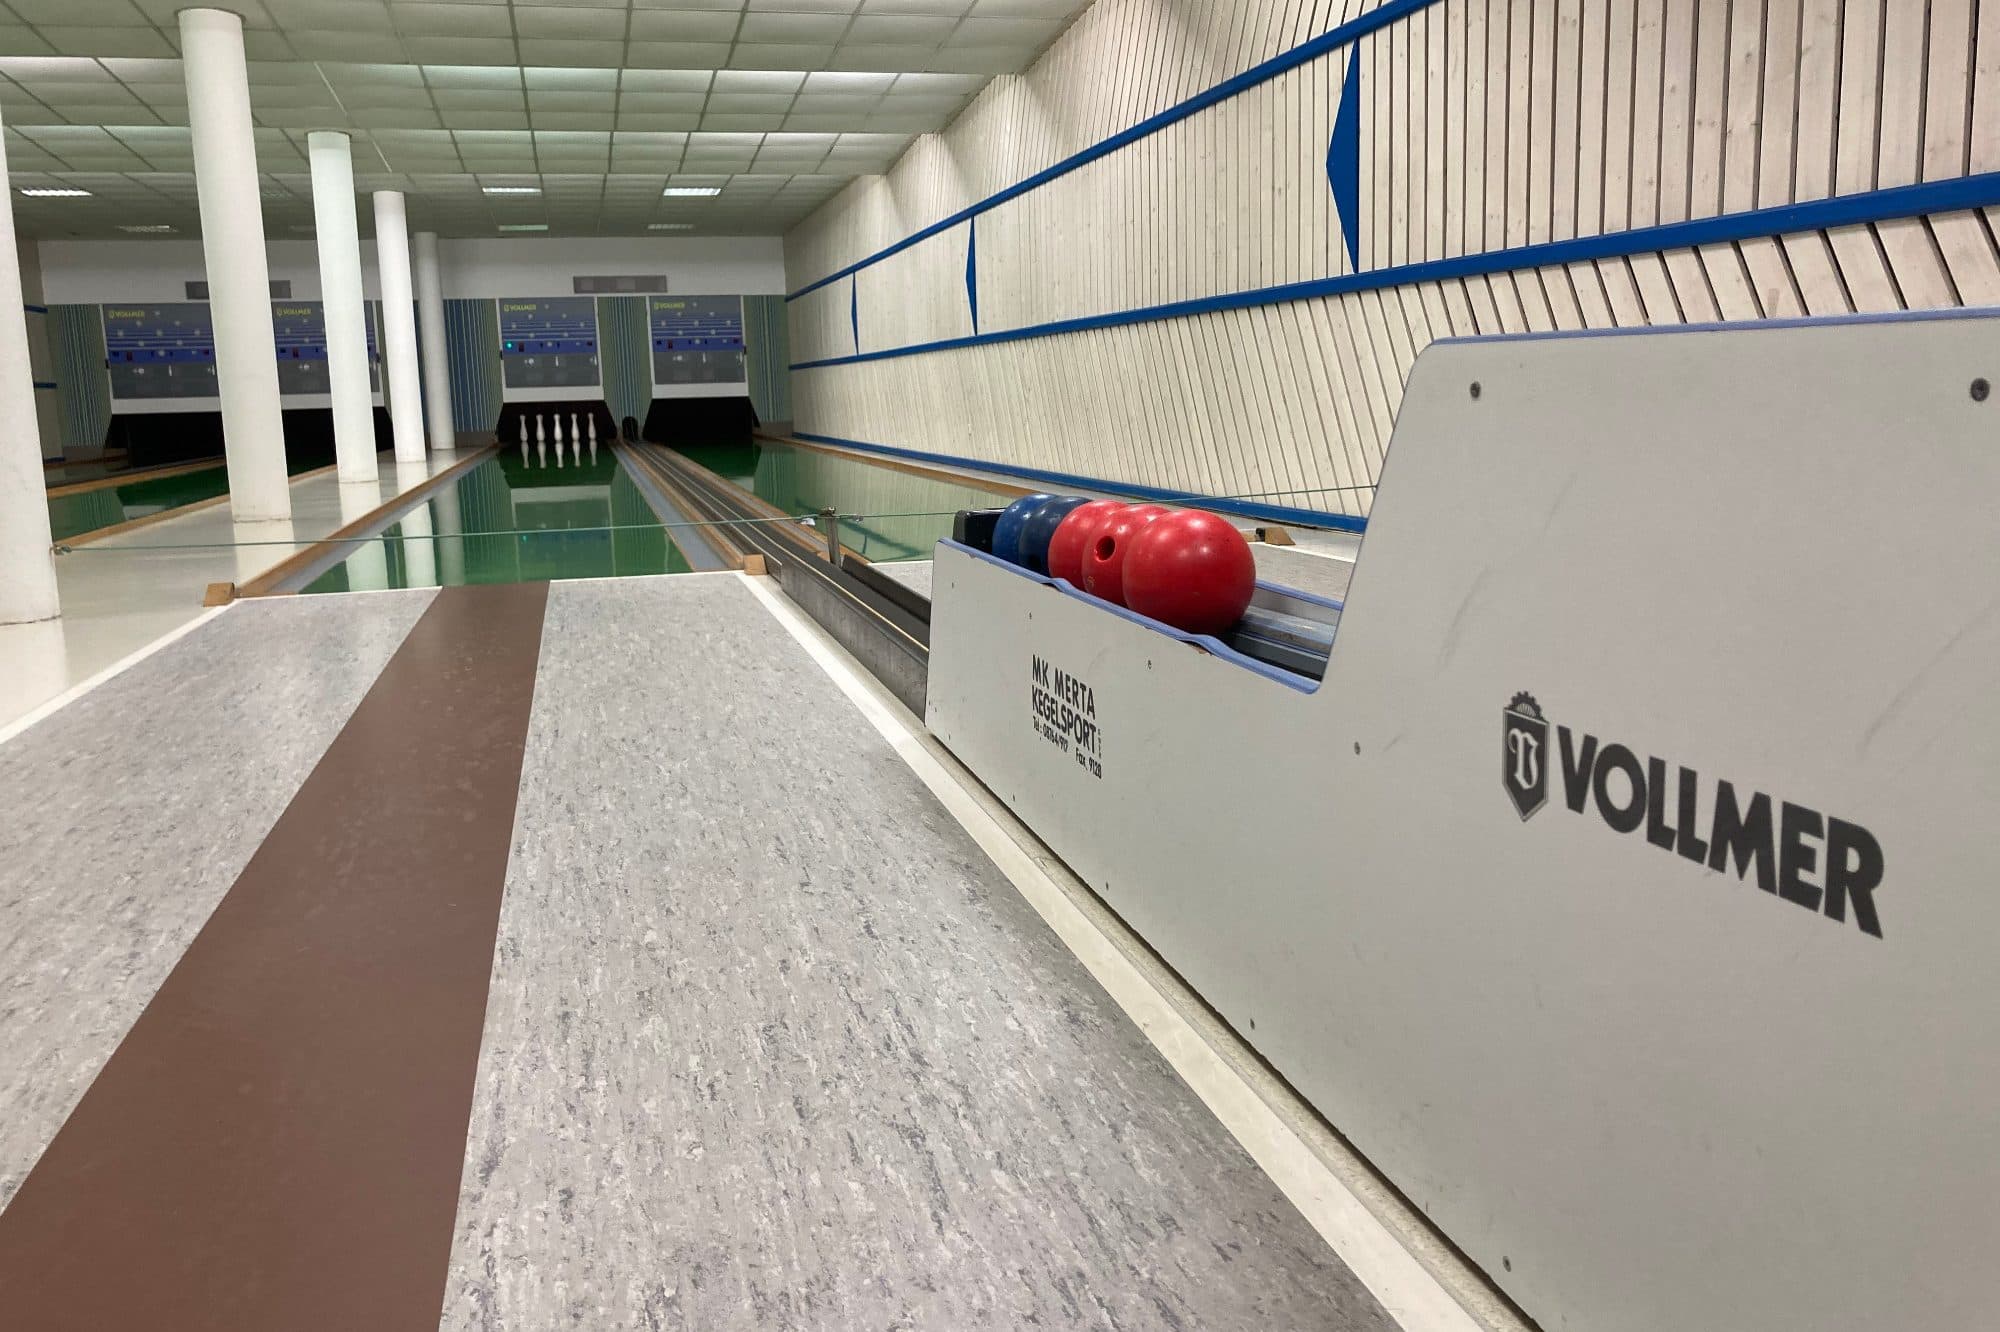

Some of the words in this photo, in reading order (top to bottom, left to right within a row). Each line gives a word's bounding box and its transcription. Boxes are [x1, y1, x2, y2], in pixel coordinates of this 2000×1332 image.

[1031, 684, 1097, 754] KEGELSPORT
[1032, 654, 1049, 689] MK
[1054, 667, 1096, 720] MERTA
[1556, 724, 1884, 940] VOLLMER
